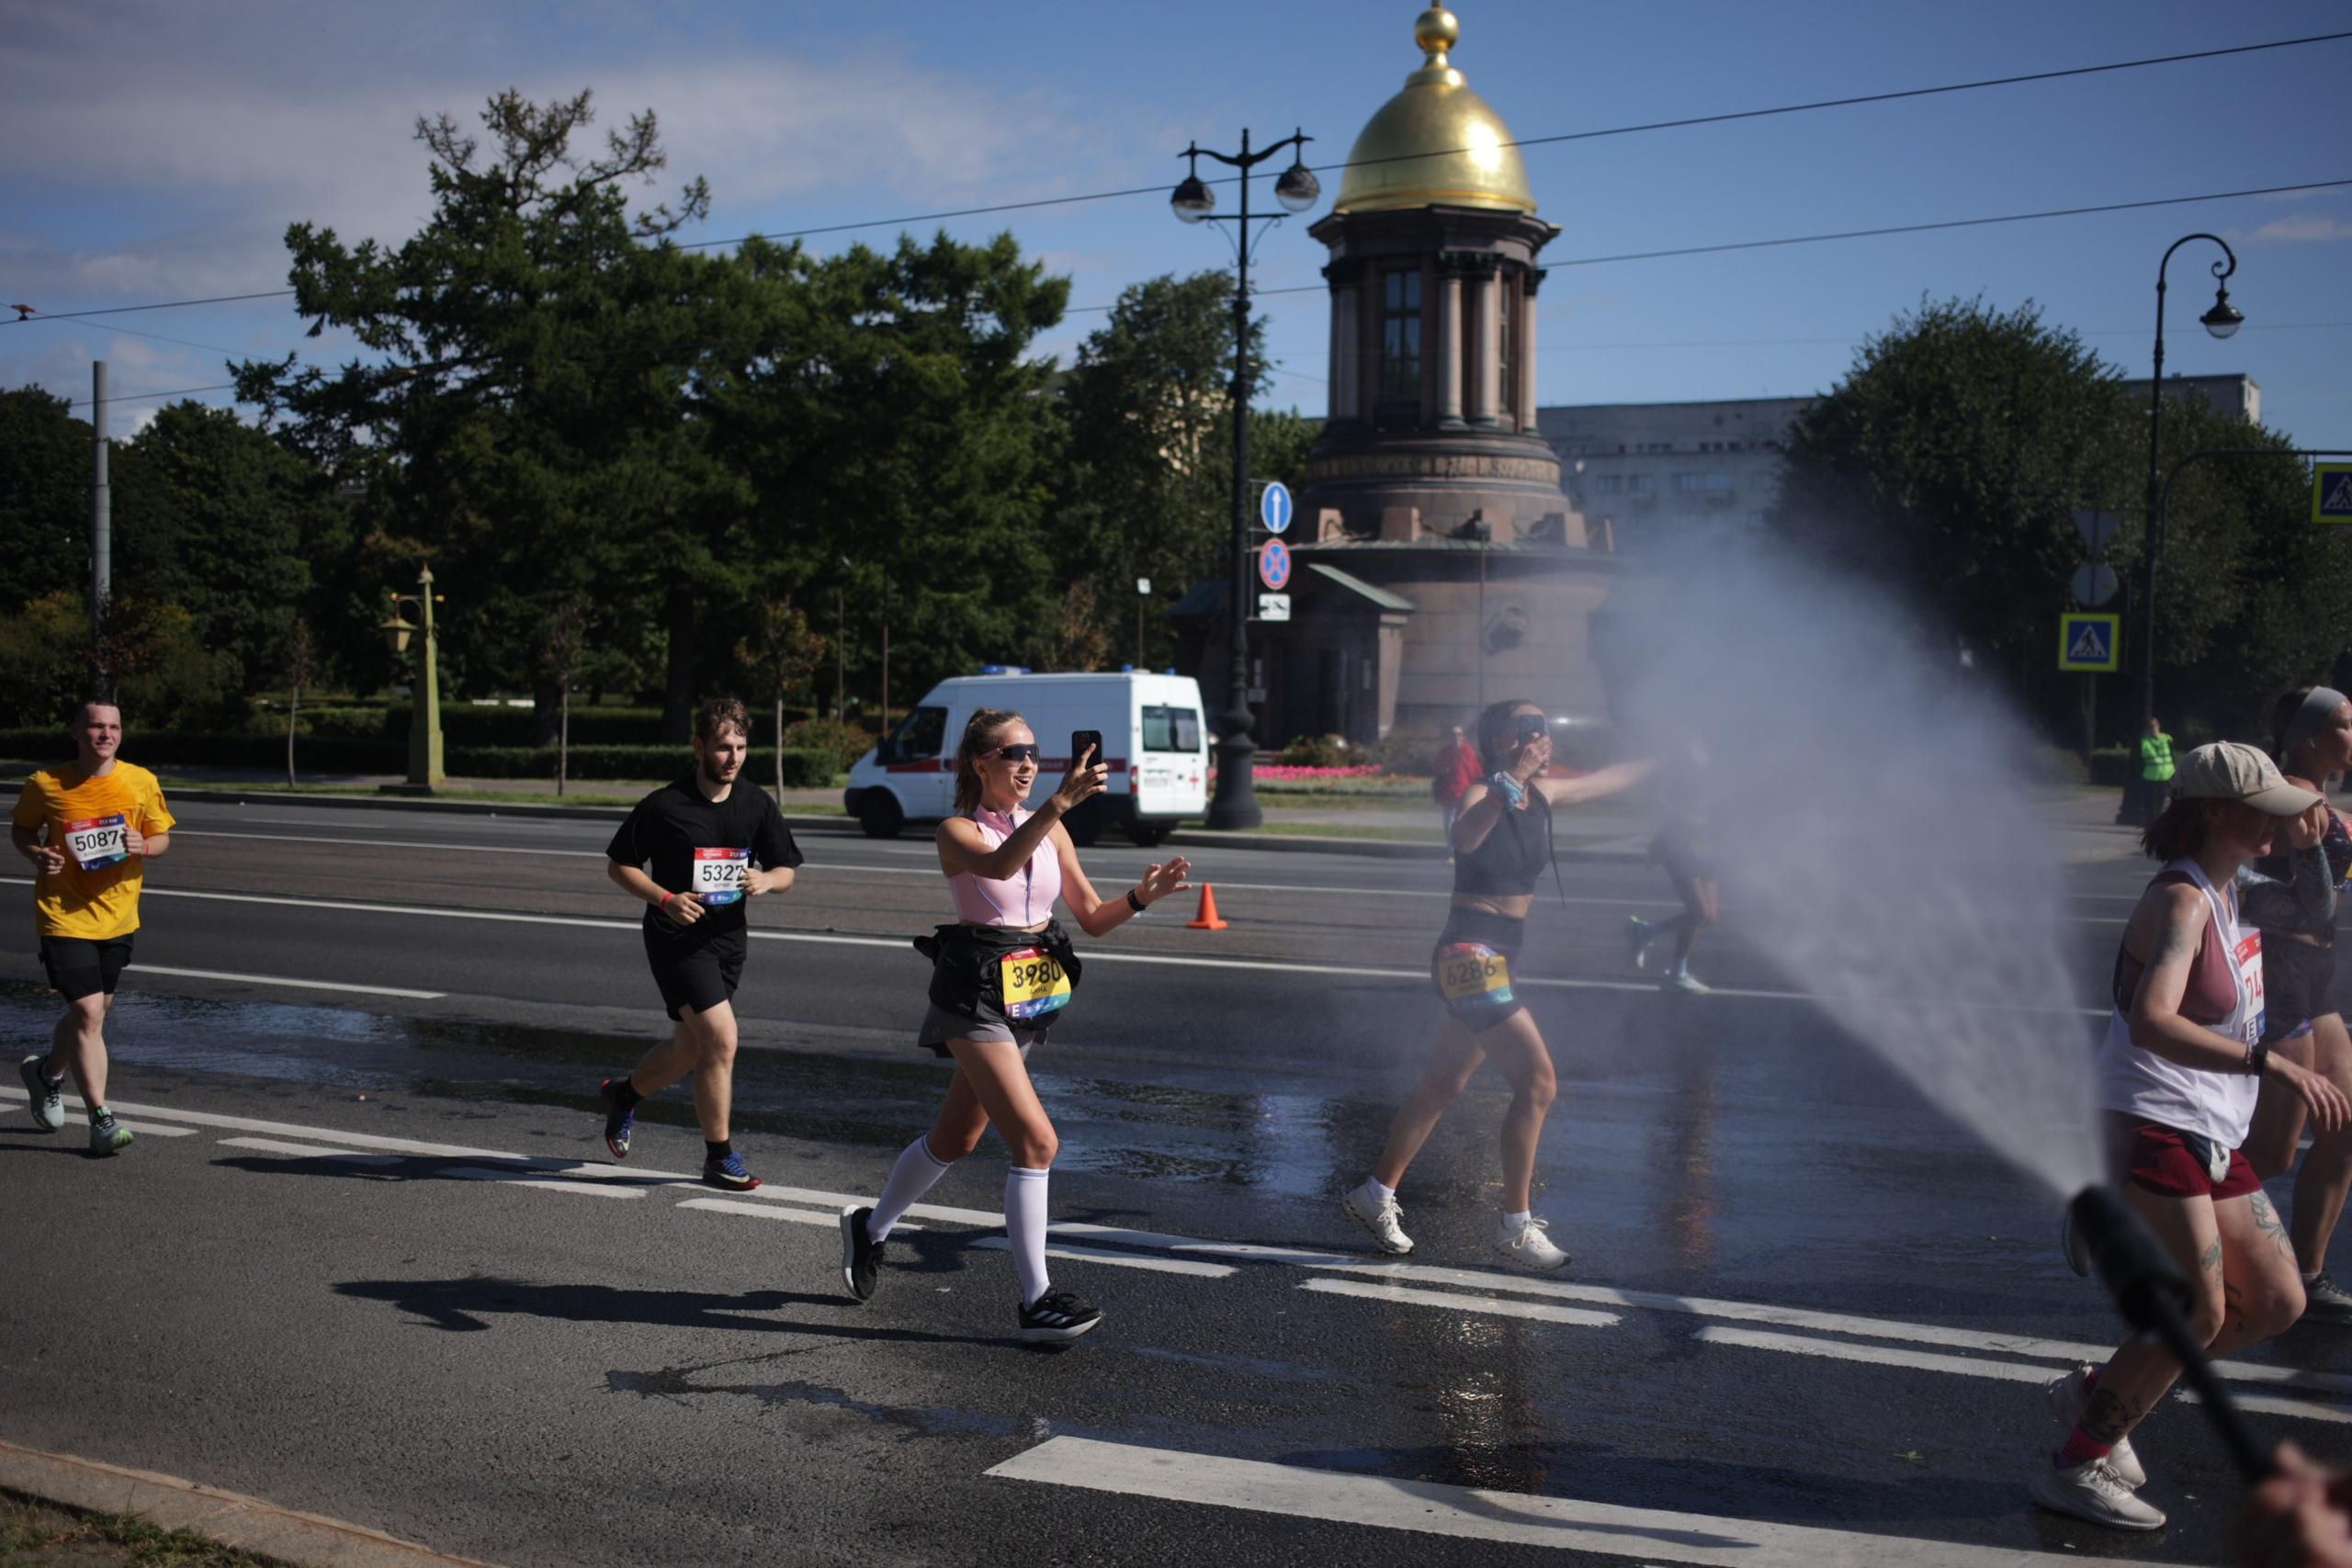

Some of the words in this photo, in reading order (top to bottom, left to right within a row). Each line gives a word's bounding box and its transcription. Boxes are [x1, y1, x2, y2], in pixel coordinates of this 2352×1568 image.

[74, 829, 119, 852] 5087
[1012, 959, 1061, 988] 3980
[1447, 957, 1497, 987] 6286
[1012, 1004, 1020, 1017] E
[2248, 1021, 2255, 1038] E
